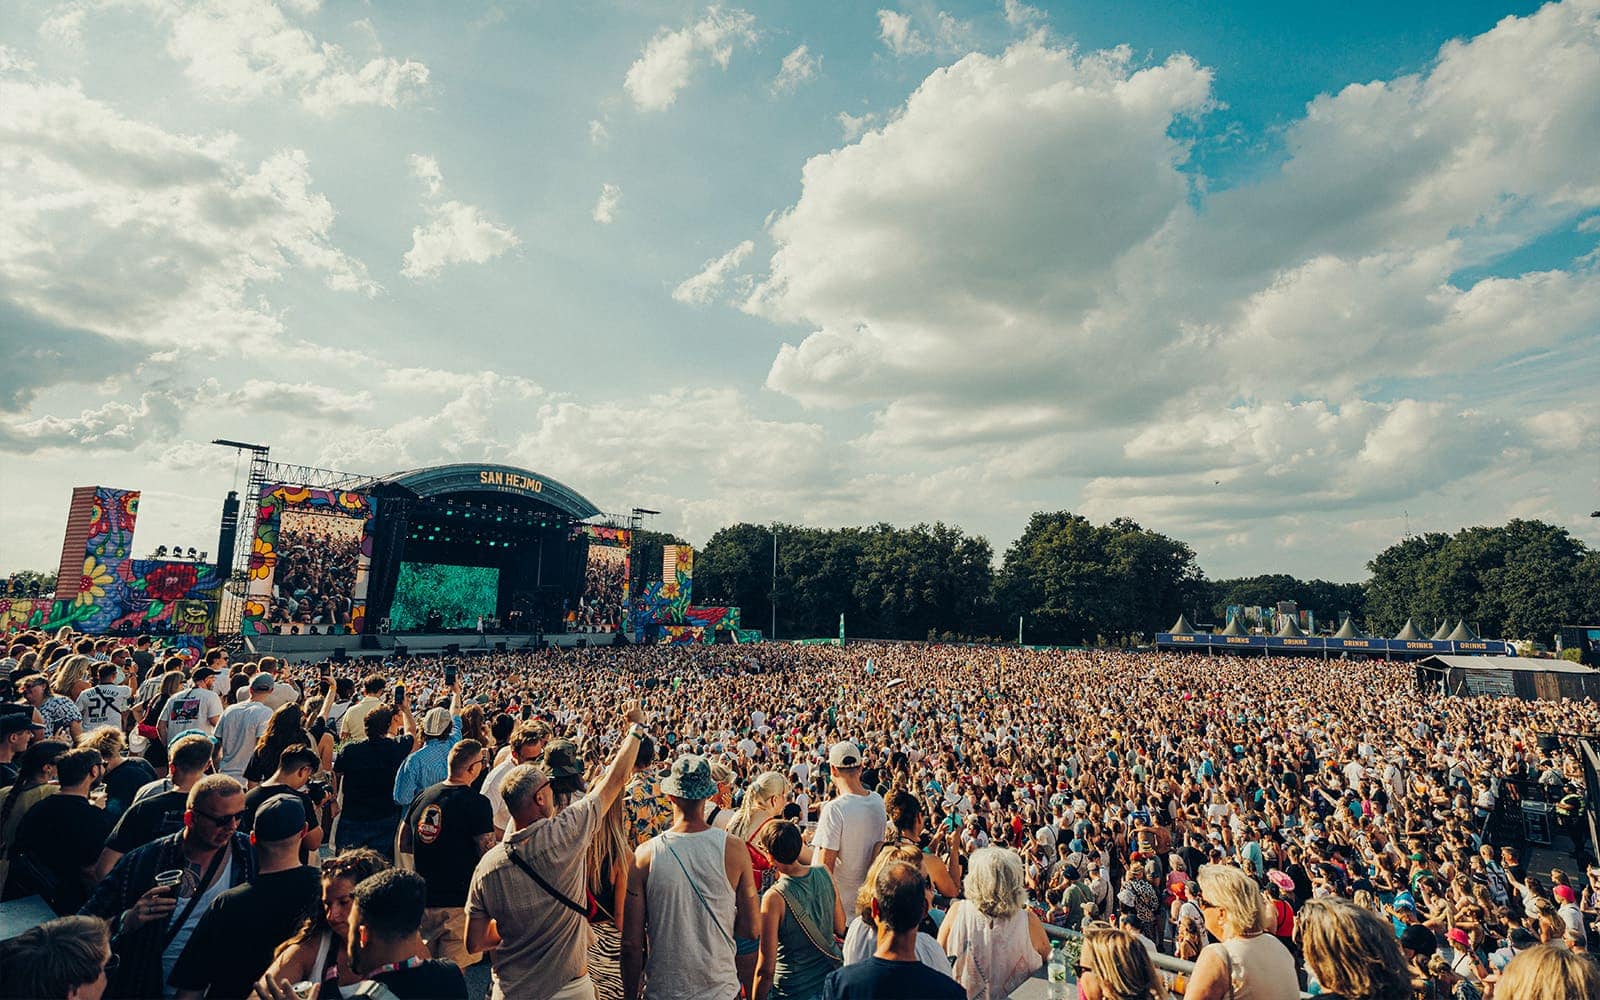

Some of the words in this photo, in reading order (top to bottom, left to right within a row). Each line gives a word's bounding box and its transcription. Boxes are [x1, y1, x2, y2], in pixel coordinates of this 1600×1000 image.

[480, 471, 503, 485] SAN
[505, 473, 542, 493] HEJMO
[1343, 640, 1369, 648] DRINKS
[1406, 641, 1434, 649] DRINKS
[1459, 642, 1487, 650] DRINKS
